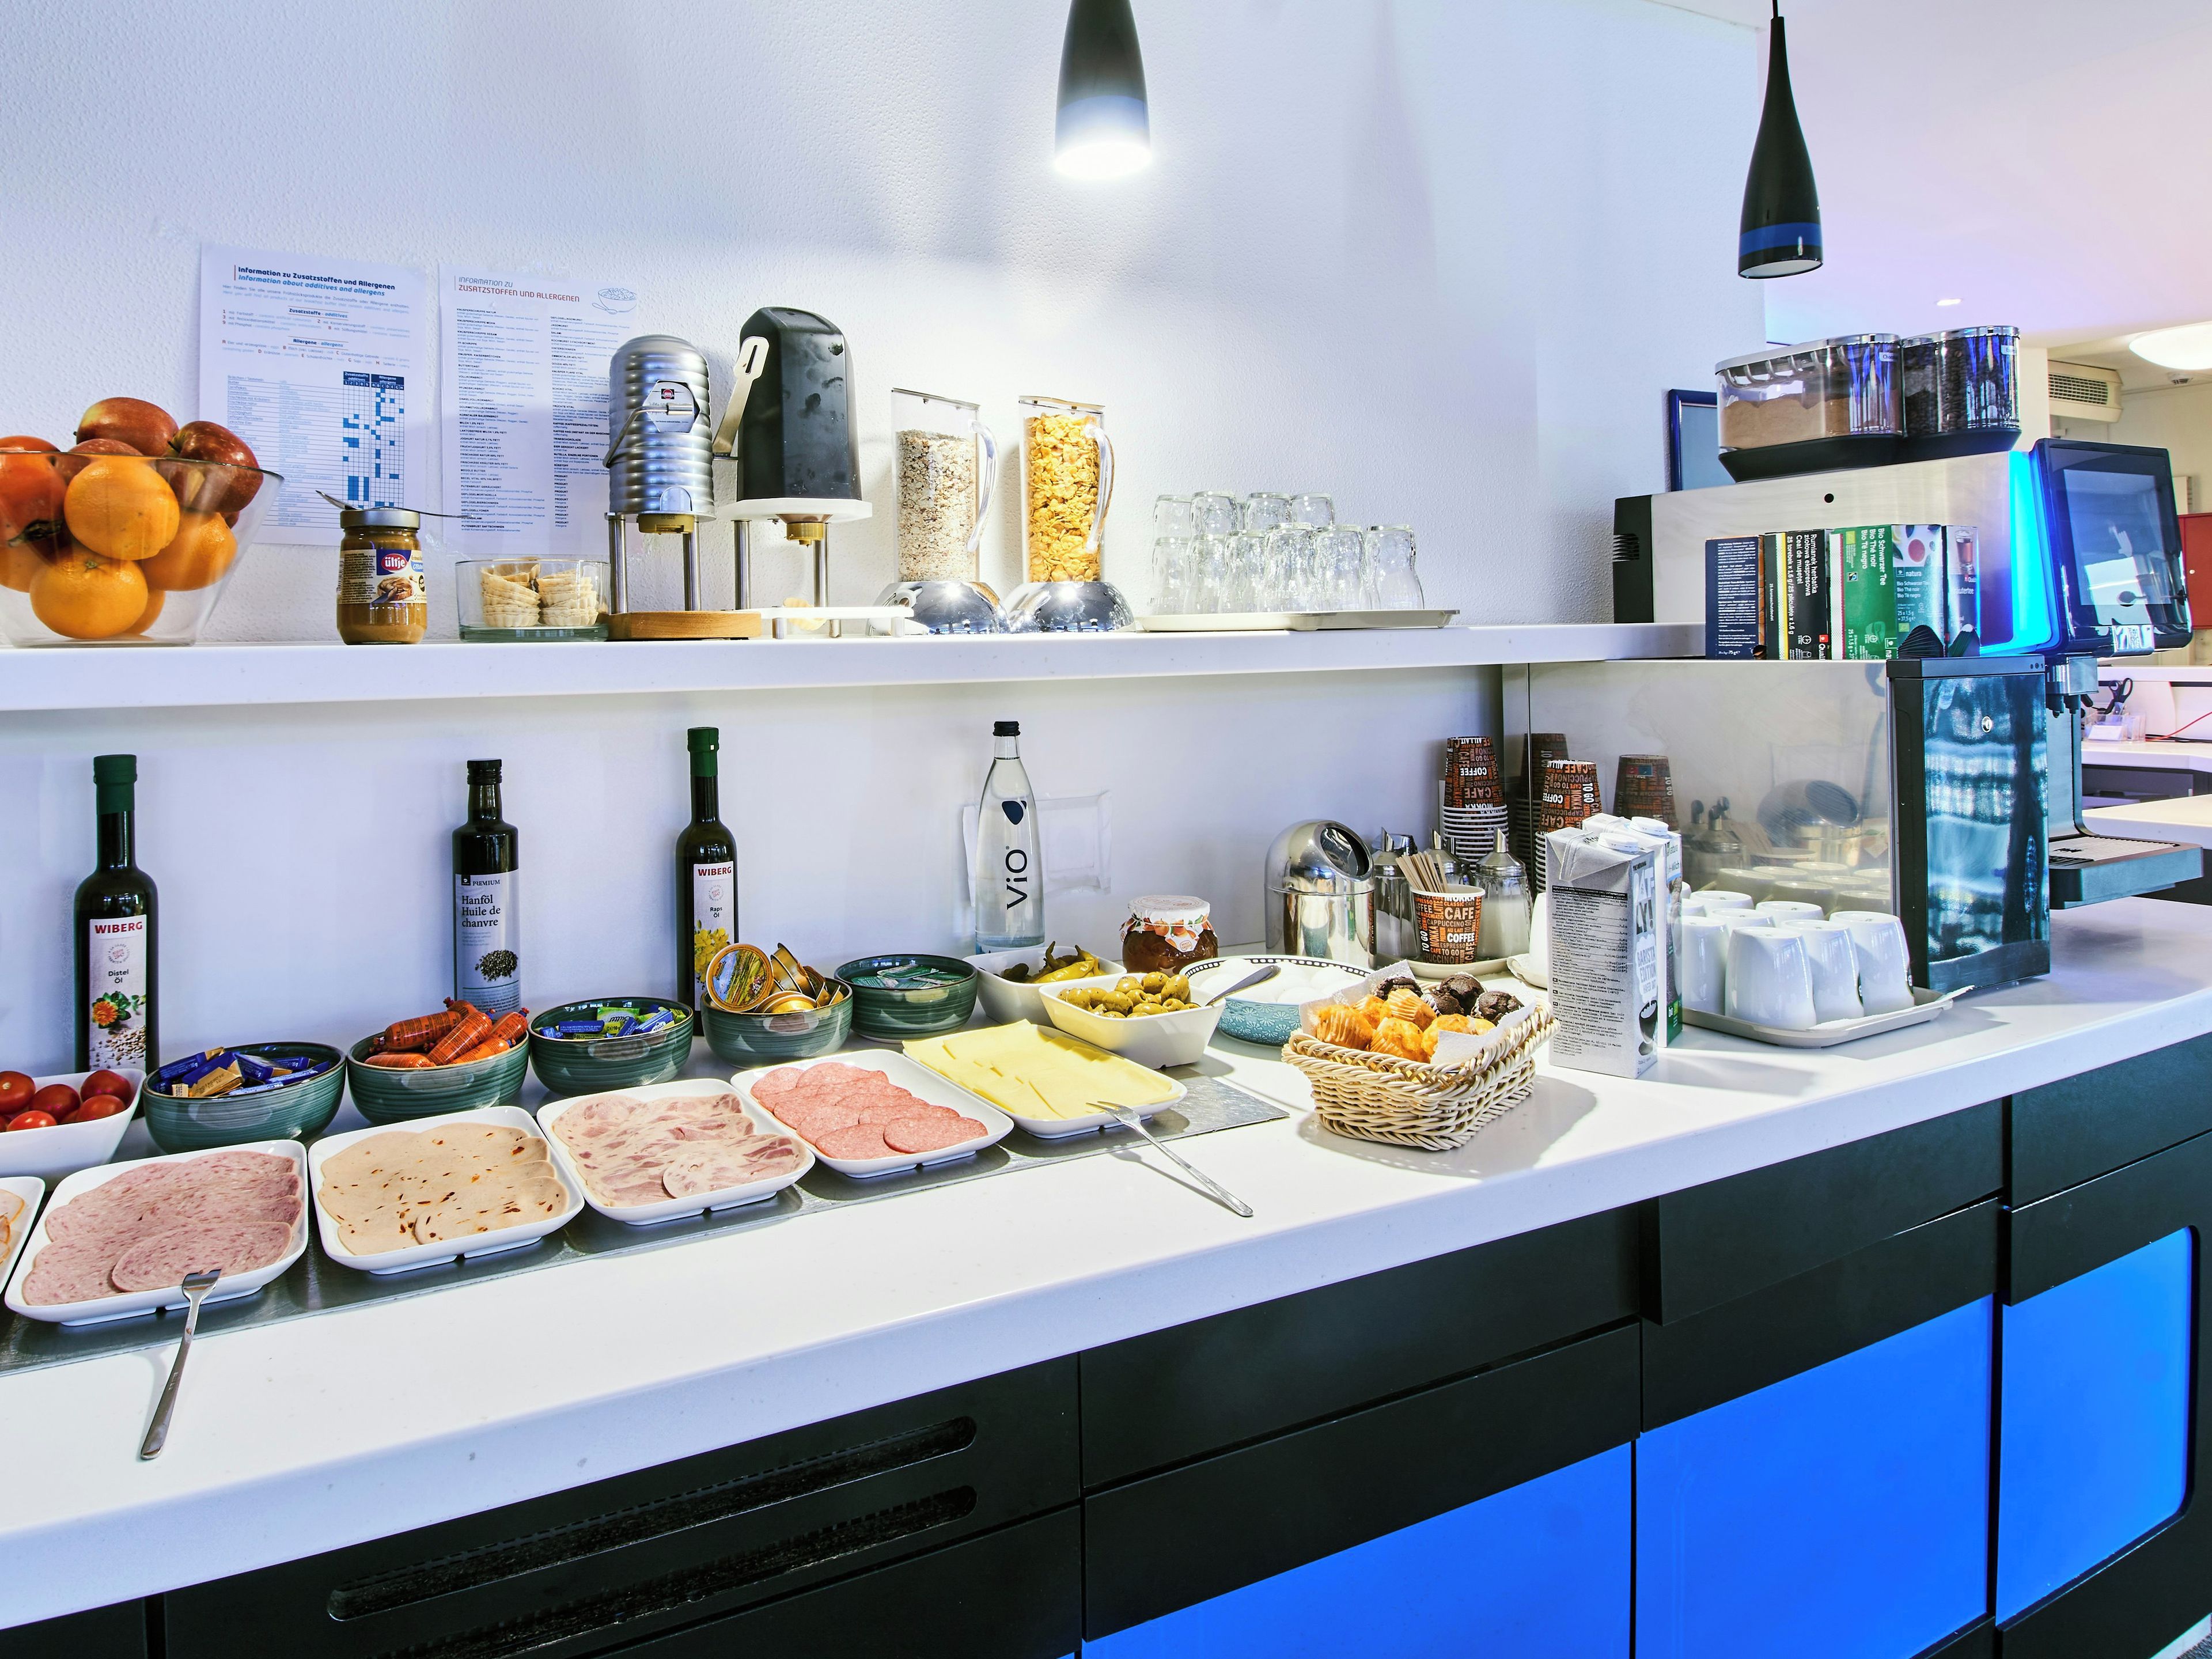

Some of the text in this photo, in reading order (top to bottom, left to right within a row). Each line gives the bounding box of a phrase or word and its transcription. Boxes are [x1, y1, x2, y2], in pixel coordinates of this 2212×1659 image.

[238, 267, 281, 276] Information
[293, 272, 342, 283] Zusatzstoffen
[358, 281, 395, 290] Allergenen
[238, 275, 281, 284] Information
[283, 278, 303, 287] about
[305, 283, 338, 291] additives
[459, 276, 503, 286] INFORMATION
[459, 285, 518, 296] ZUSATZSTOFFEN
[536, 292, 579, 302] ALLERGENEN
[1862, 541, 1868, 549] Té
[384, 556, 406, 569] ültje
[1460, 767, 1487, 776] COFFEE
[1464, 787, 1491, 798] CAFE
[1543, 793, 1563, 804] COFFEE
[1582, 783, 1594, 803] TO GO
[1571, 790, 1582, 810] MOKKA
[1541, 814, 1564, 828] CAFE
[698, 866, 732, 876] WIBERG
[1005, 849, 1028, 910] ViO
[461, 894, 493, 904] Hanföl
[461, 906, 501, 916] Huile de
[1421, 912, 1444, 920] MACCHIATO
[1444, 907, 1474, 920] CAFE
[94, 921, 143, 934] WIBERG
[461, 918, 498, 927] chanvre
[1427, 919, 1464, 927] CAPPUCCINO
[1420, 930, 1430, 952] TO GO
[1429, 926, 1440, 948] MOKKA
[1446, 933, 1475, 943] COFFEE
[1465, 941, 1475, 961] CAFE
